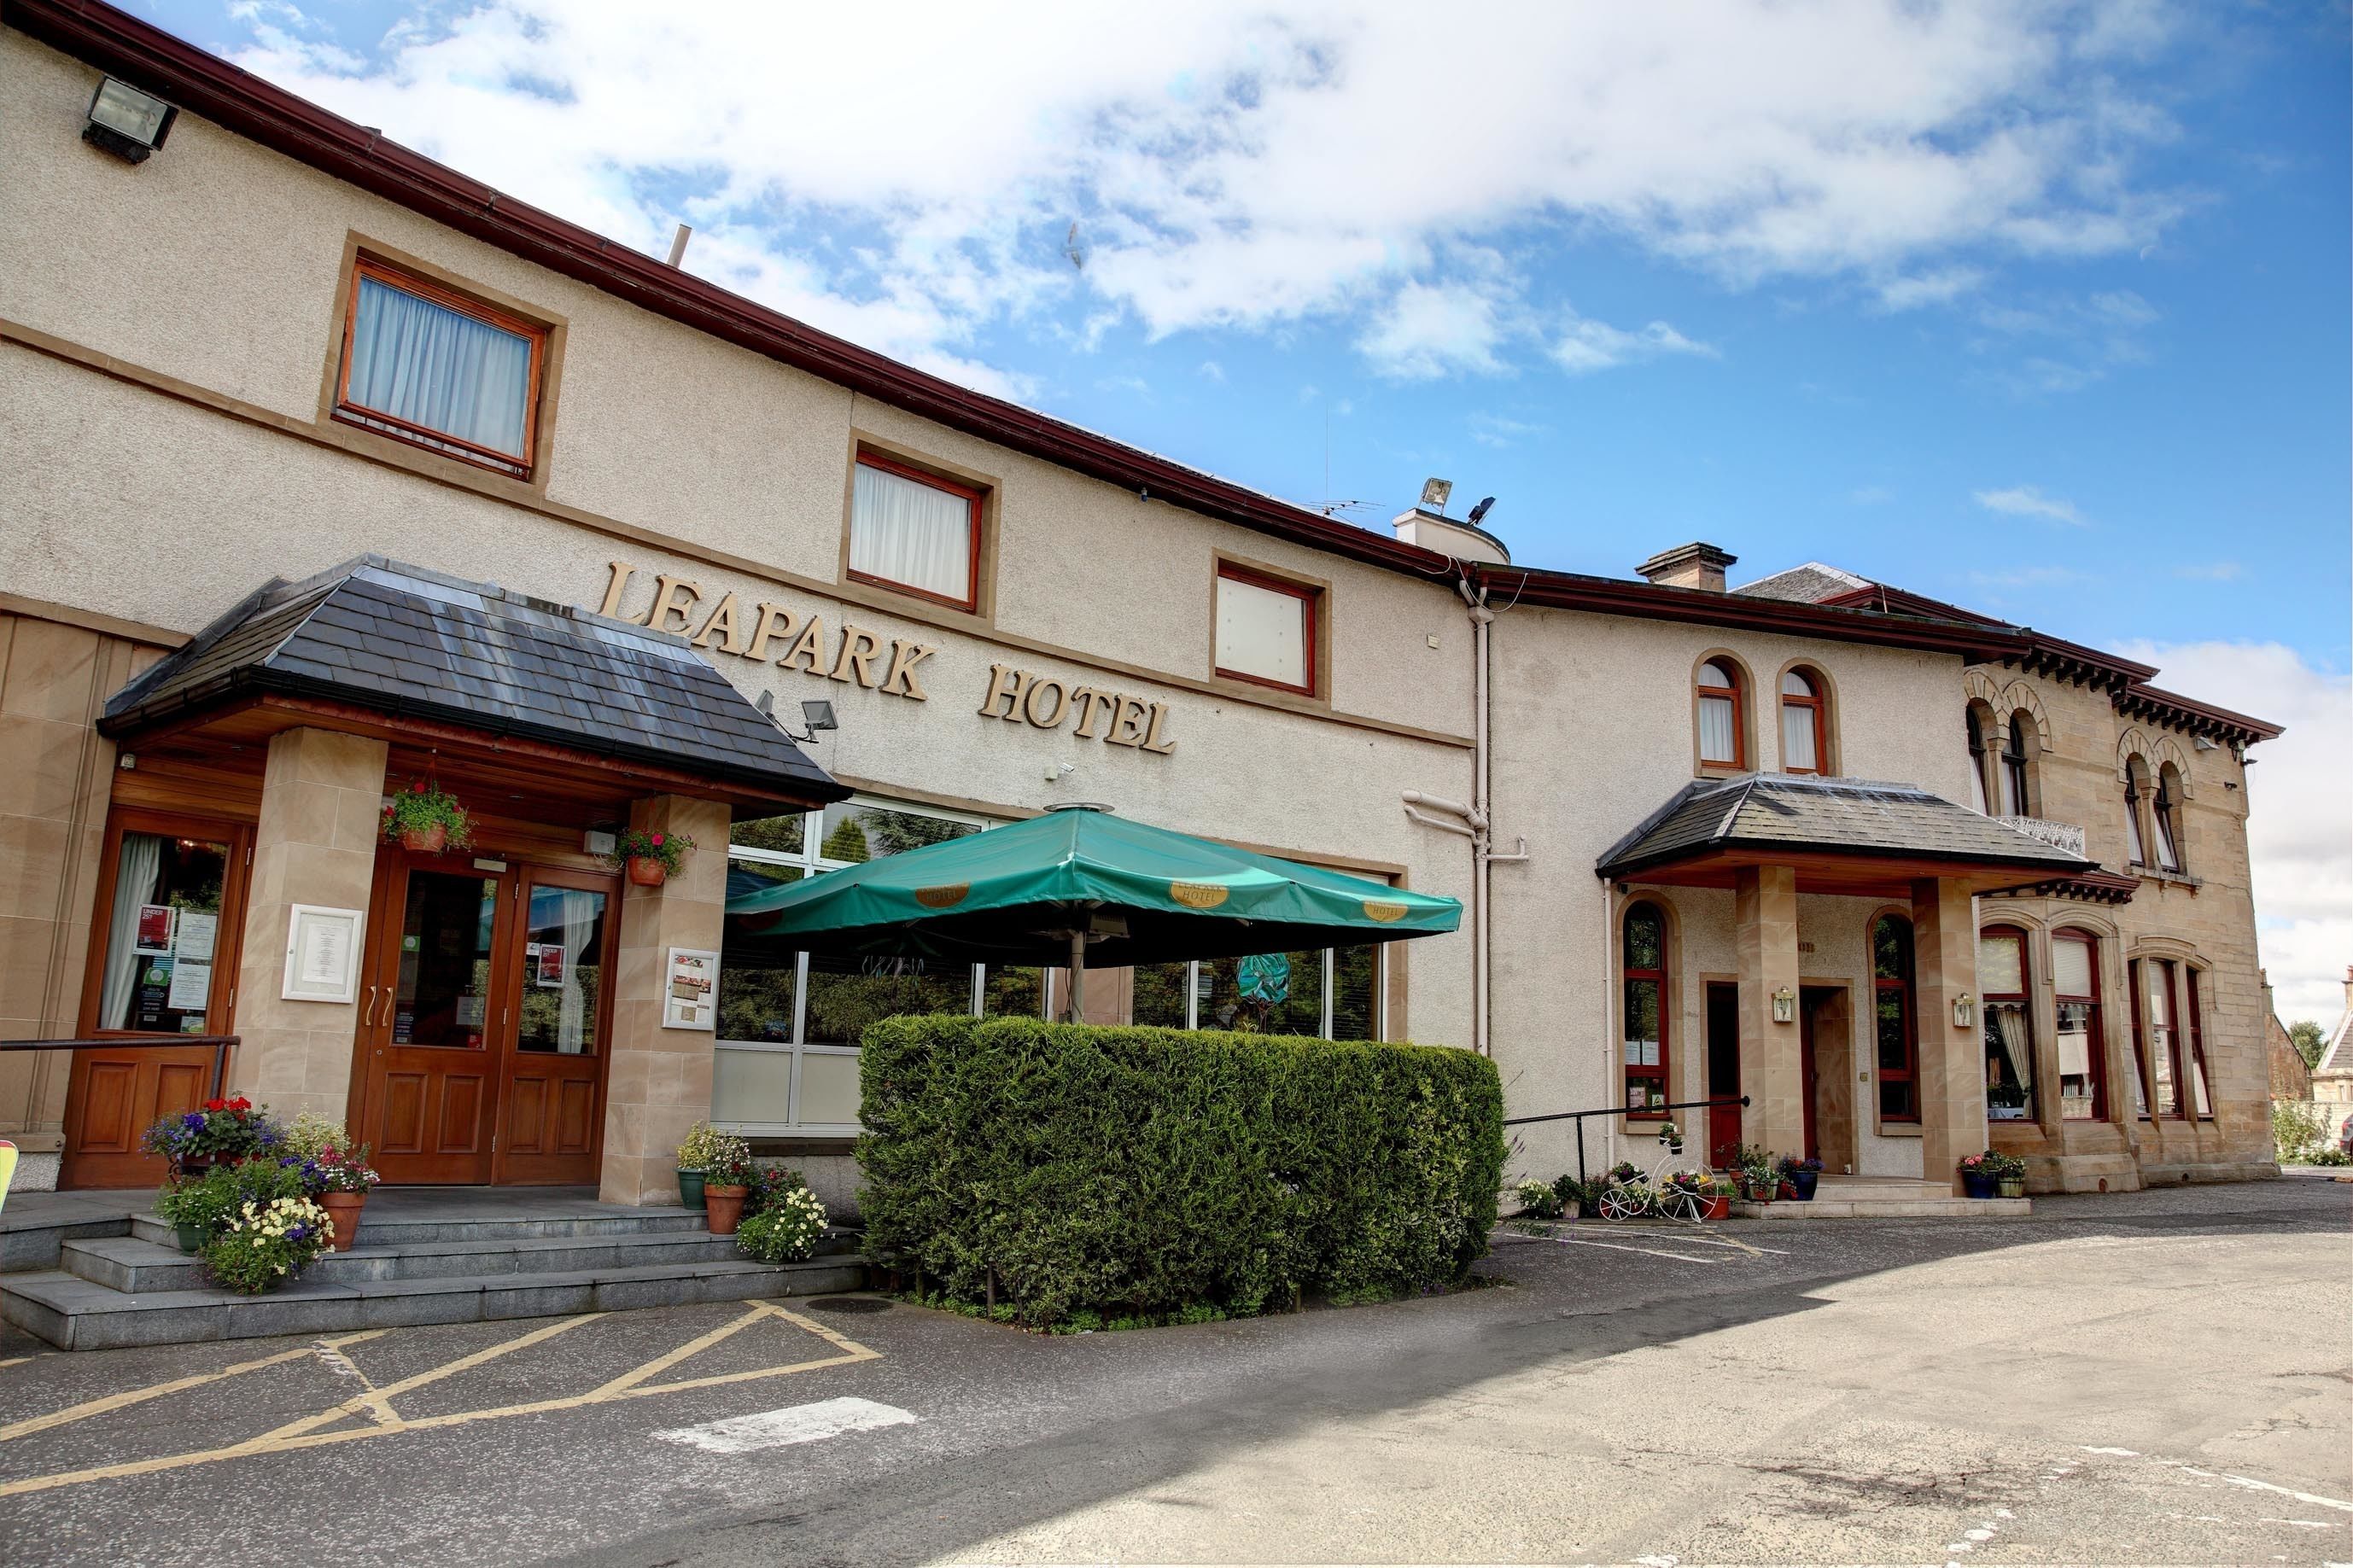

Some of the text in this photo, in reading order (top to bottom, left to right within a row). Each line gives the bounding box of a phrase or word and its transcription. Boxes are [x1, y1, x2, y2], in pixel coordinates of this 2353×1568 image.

[598, 561, 1176, 755] LEAPARK HOTEL
[1182, 889, 1216, 902] HOTEL
[1373, 906, 1398, 916] HOTEL
